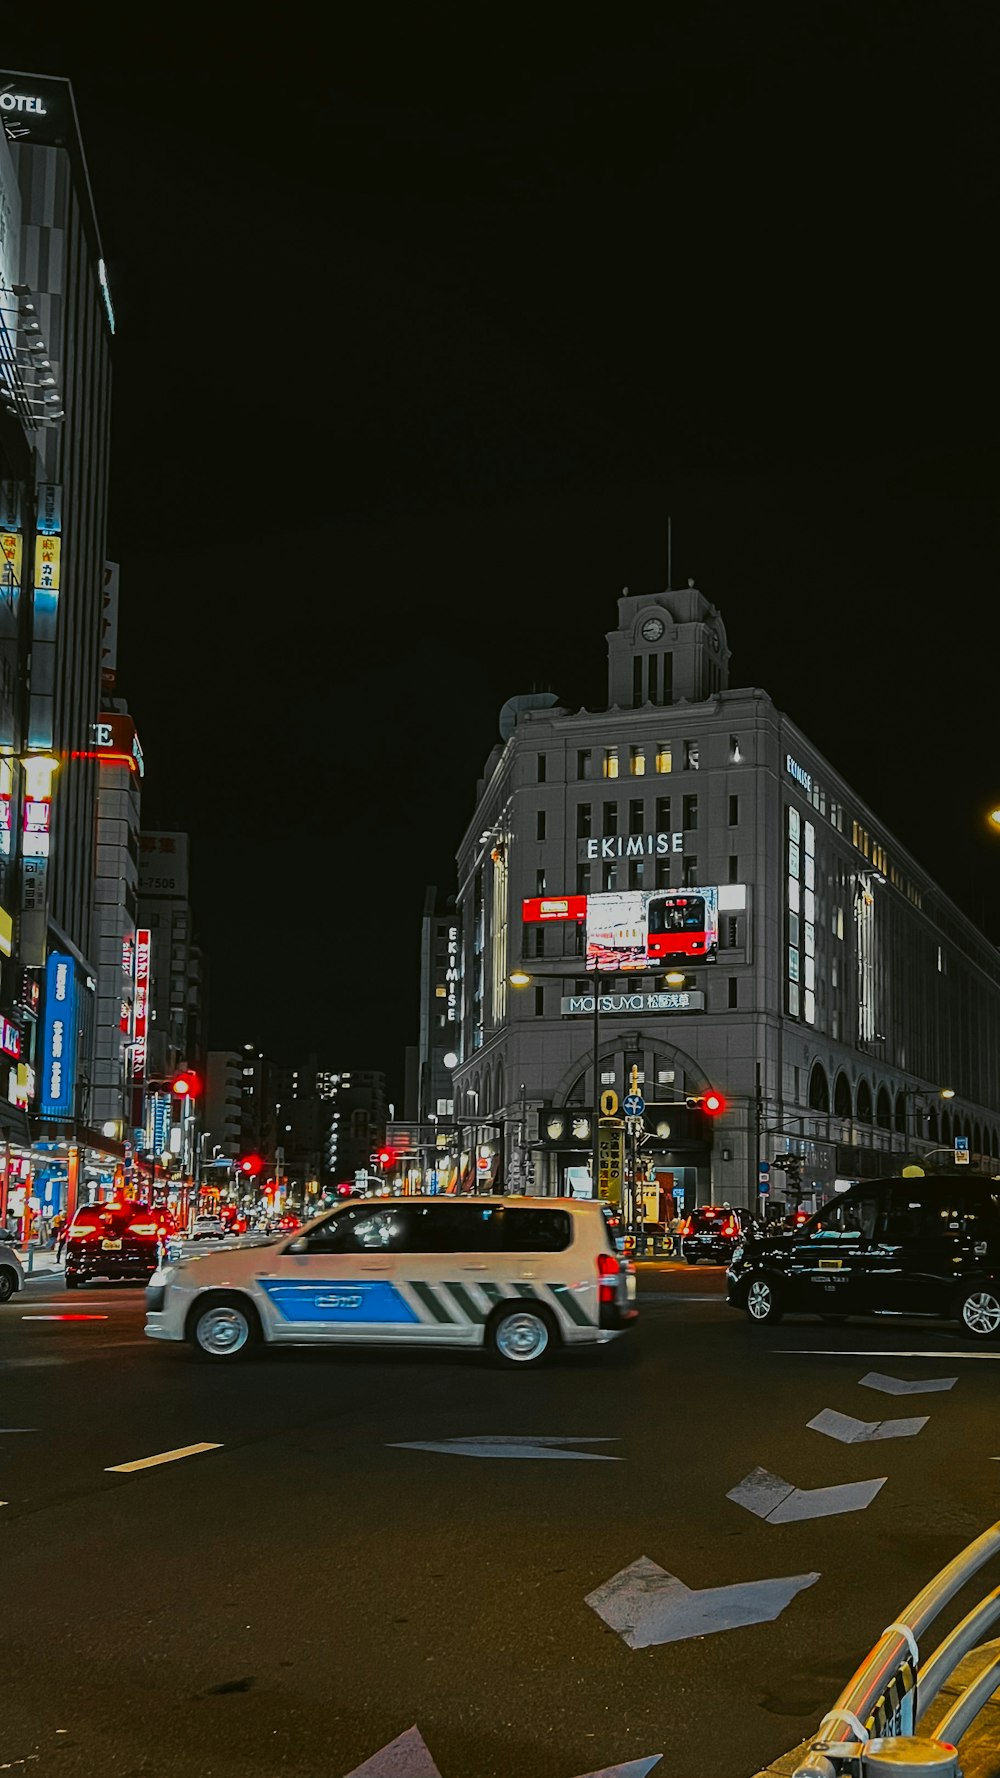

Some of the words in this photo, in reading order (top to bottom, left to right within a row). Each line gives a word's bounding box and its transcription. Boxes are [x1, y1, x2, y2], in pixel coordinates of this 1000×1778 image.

[0, 93, 47, 115] OTEL
[787, 754, 812, 792] EKIMISE
[587, 833, 683, 858] EKIMISE
[446, 927, 459, 1021] EKIMISE
